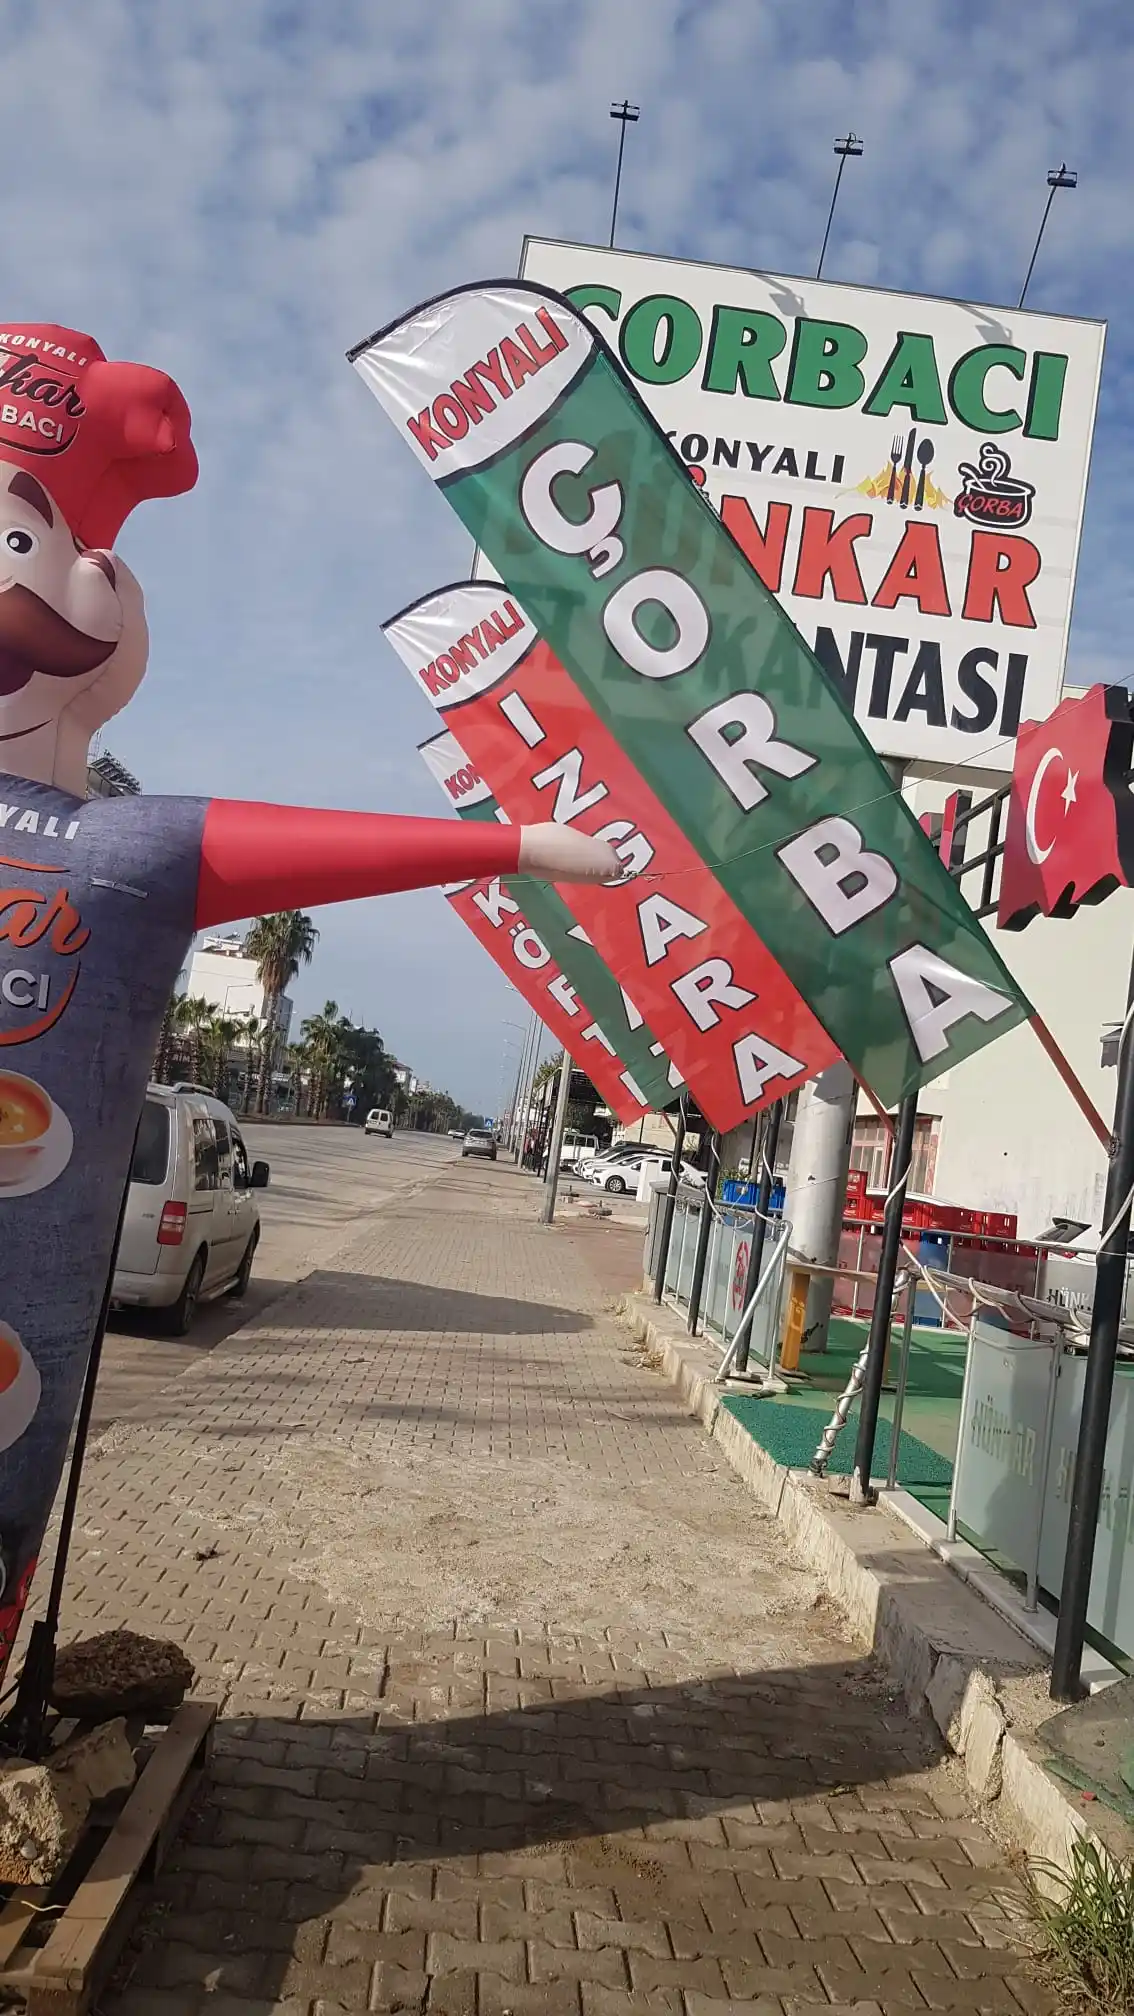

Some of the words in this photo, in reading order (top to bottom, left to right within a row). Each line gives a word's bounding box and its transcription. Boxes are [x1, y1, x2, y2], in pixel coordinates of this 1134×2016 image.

[406, 306, 570, 461] KONYALI
[664, 433, 845, 484] ONYALI
[956, 494, 1023, 518] ÇORBA
[418, 599, 526, 696] KONYALI
[519, 438, 1016, 1067] ÇORBA
